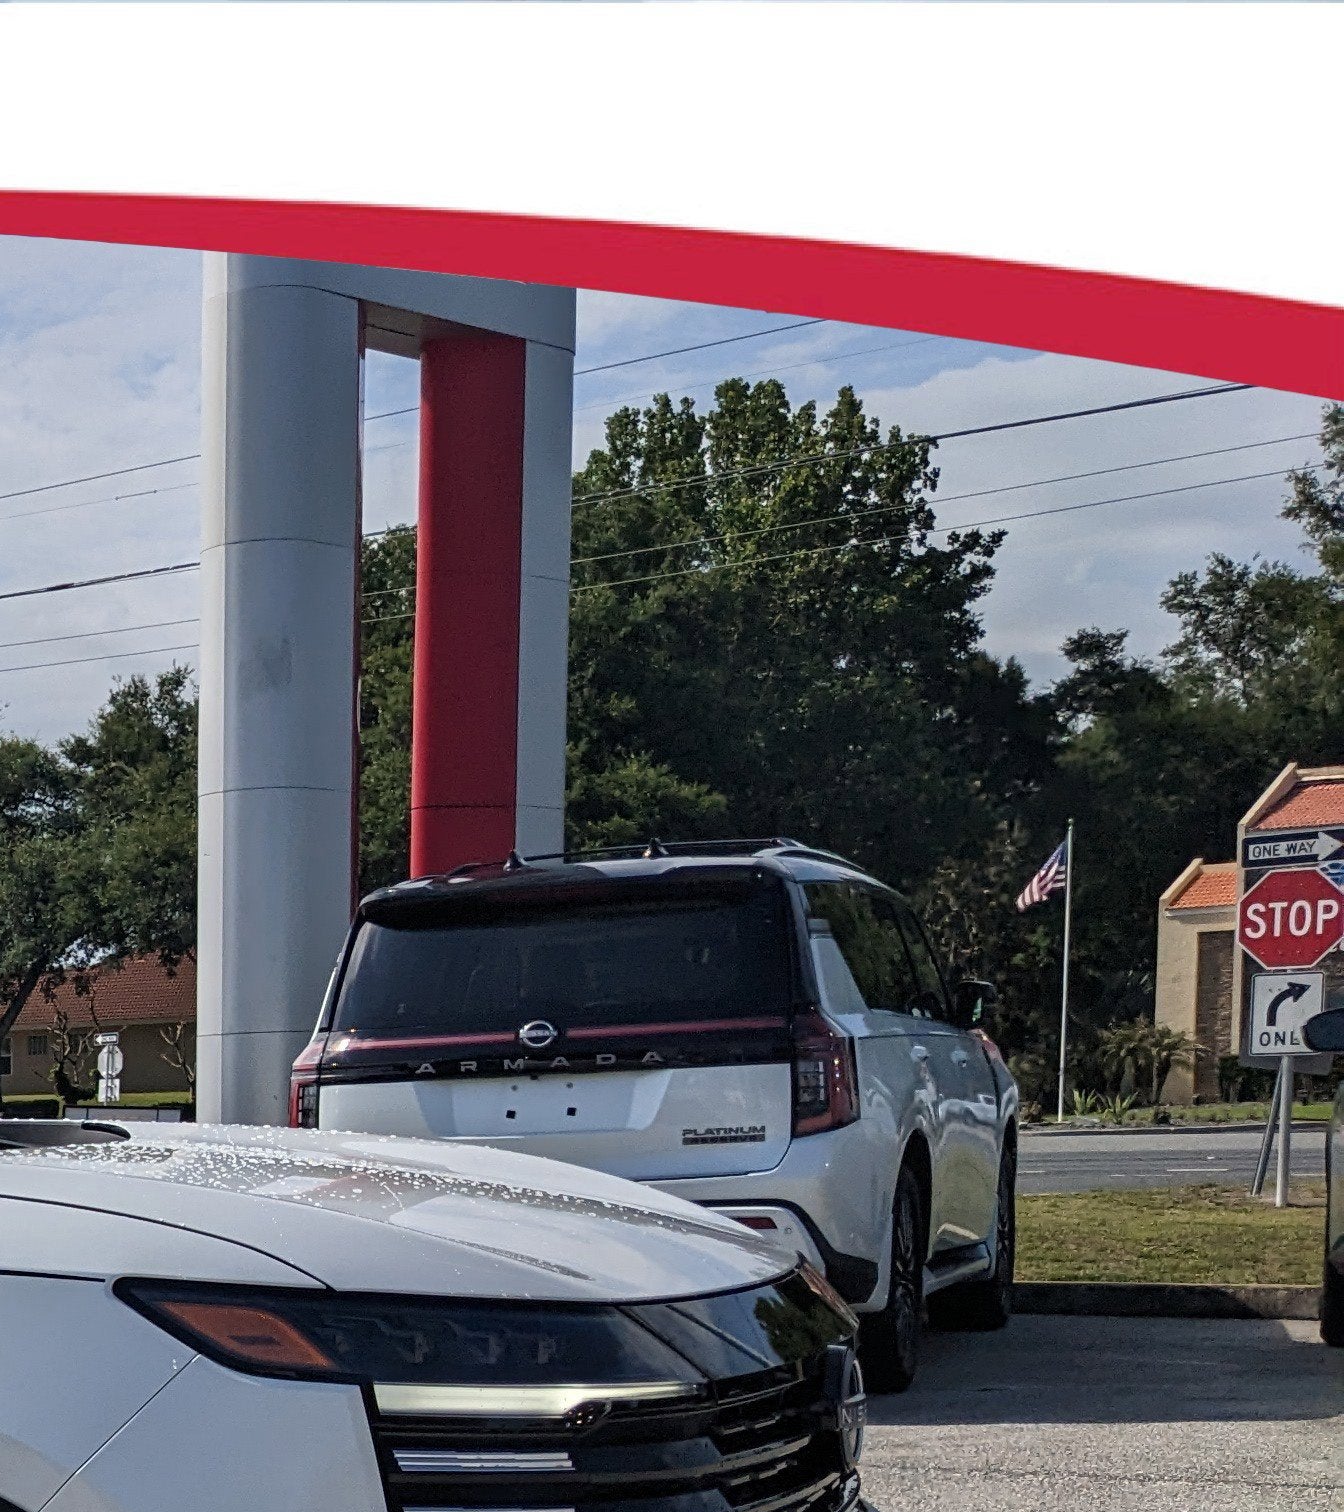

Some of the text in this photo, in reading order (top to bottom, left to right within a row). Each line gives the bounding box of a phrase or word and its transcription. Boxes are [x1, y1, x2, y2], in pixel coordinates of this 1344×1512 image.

[1252, 840, 1316, 858] ONE WAY
[1244, 899, 1339, 939] STOP
[1259, 1030, 1300, 1047] ONL
[415, 1051, 662, 1074] ARMADA
[682, 1125, 766, 1137] PLATINUM
